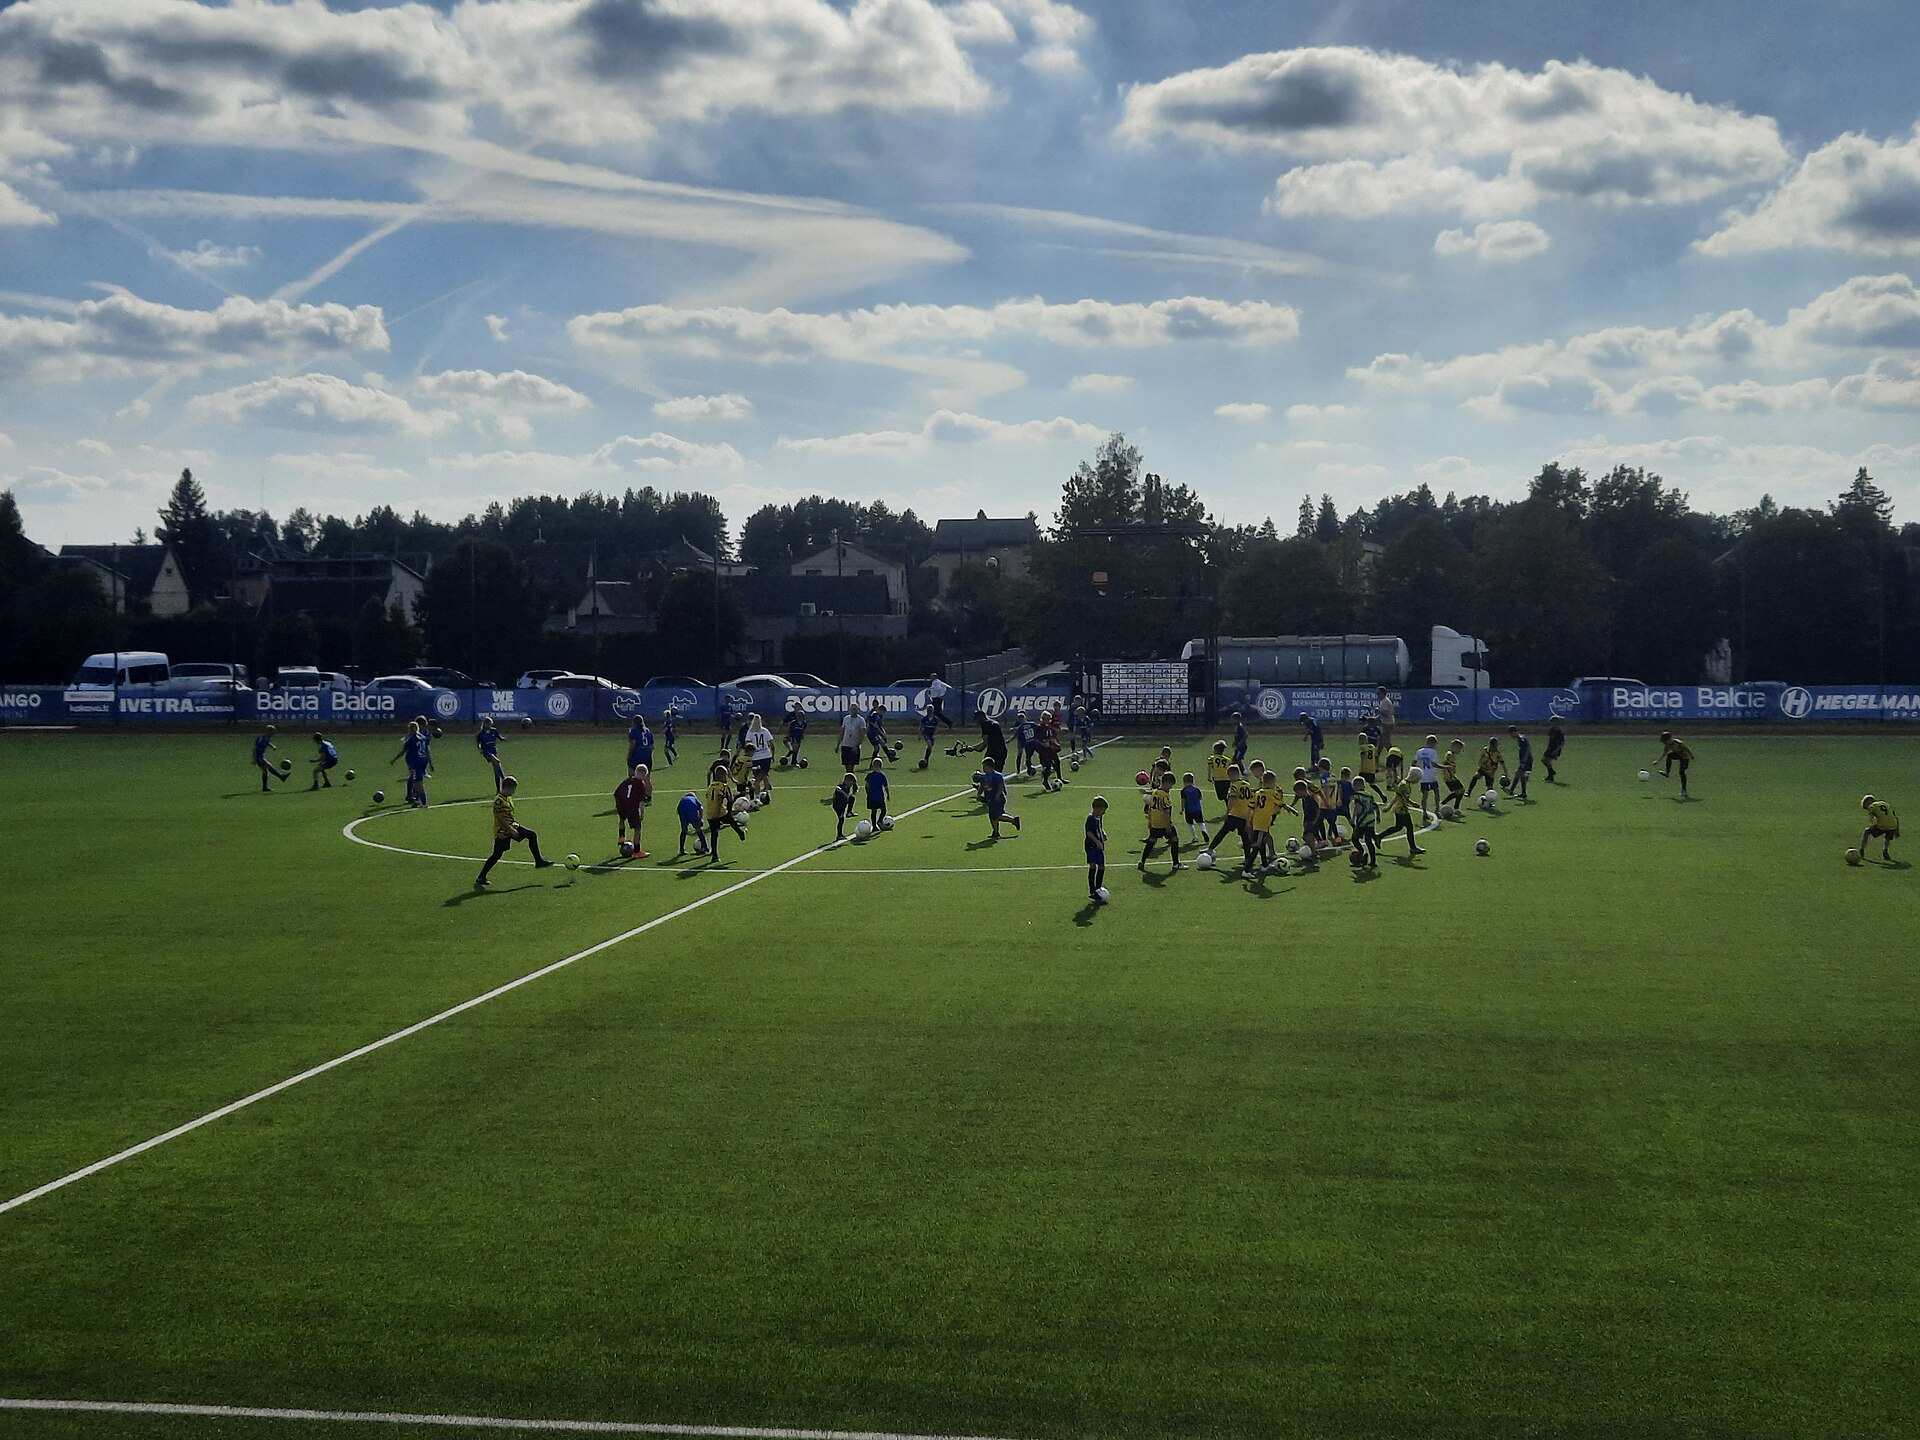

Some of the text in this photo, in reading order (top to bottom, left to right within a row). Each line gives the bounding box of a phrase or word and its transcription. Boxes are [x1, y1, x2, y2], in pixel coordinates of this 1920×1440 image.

[257, 691, 319, 711] Balcia
[331, 691, 395, 711] Balcia
[492, 691, 514, 702] WE
[785, 688, 907, 713] aconitum
[1613, 688, 1682, 708] Balcia
[1698, 687, 1765, 708] Balcia
[119, 698, 194, 712] IVETRA
[492, 703, 514, 711] ONE
[641, 731, 648, 746] 5
[754, 733, 765, 748] 14
[1215, 757, 1227, 768] 99
[626, 784, 632, 799] 1
